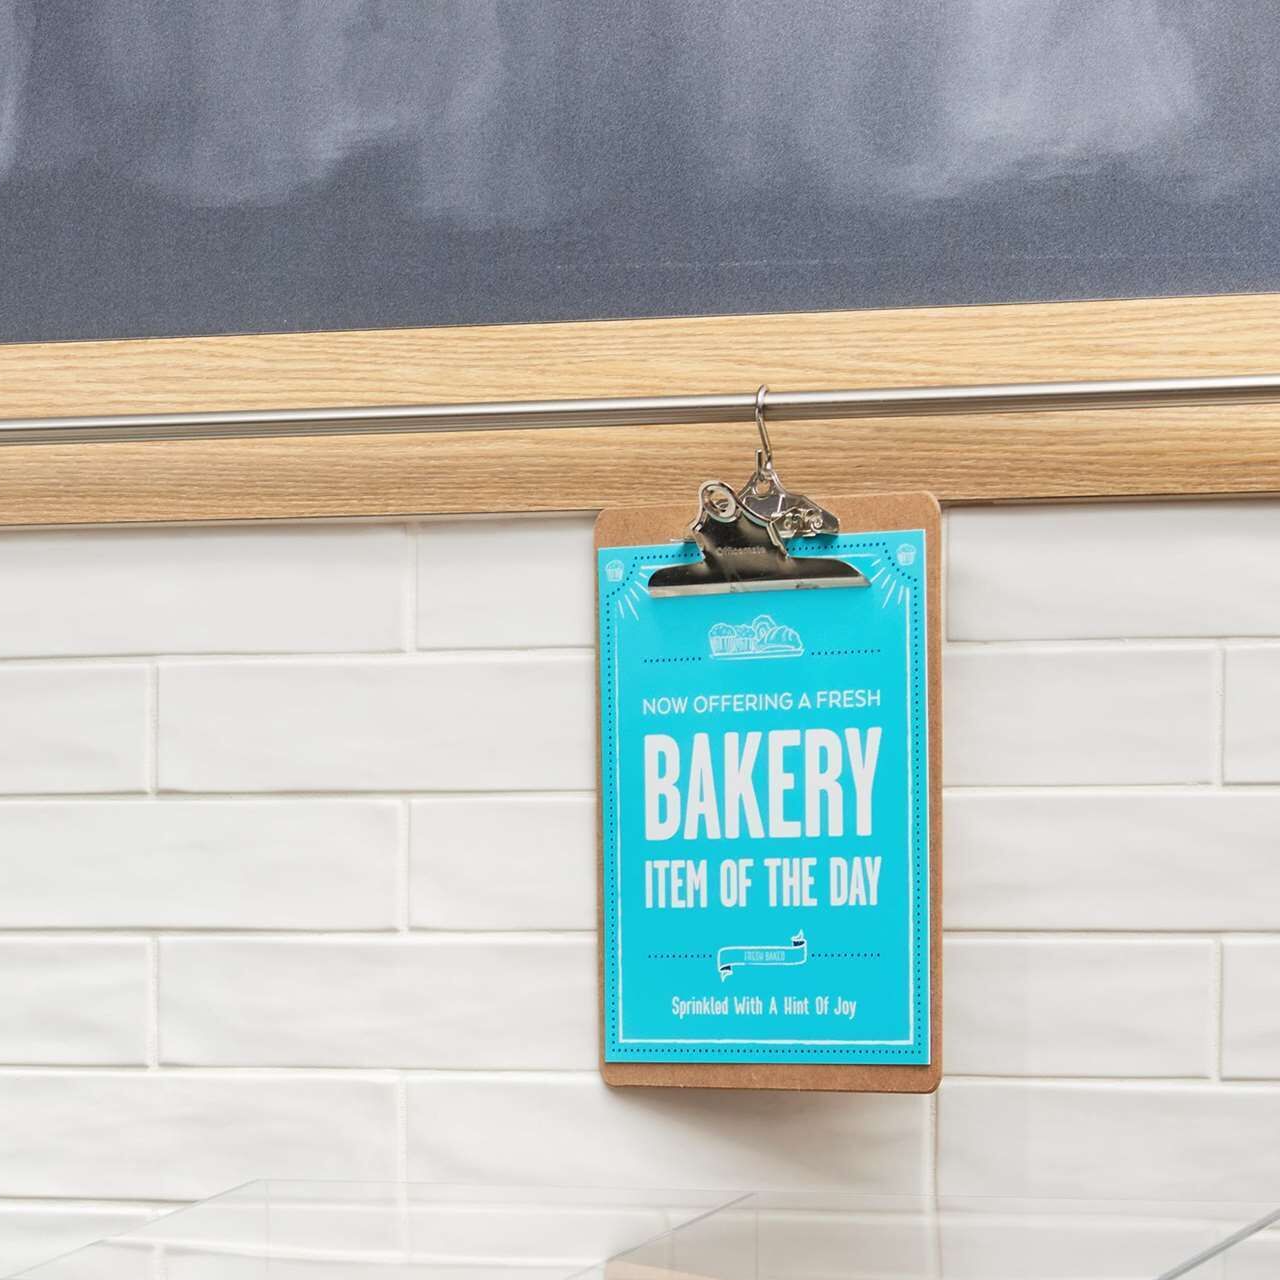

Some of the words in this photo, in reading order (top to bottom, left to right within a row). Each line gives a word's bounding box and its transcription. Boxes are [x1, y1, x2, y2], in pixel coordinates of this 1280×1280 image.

[642, 697, 688, 715] NOW
[693, 693, 793, 713] OFFERING
[798, 694, 812, 709] A
[816, 689, 881, 708] FRESH
[643, 726, 883, 841] BAKERY
[645, 858, 708, 909] ITEM
[720, 858, 754, 908] OF
[764, 857, 818, 907] THE
[829, 855, 883, 906] DAY
[671, 996, 728, 1020] Sprinkled
[734, 996, 763, 1015] With
[768, 996, 778, 1016] A
[783, 996, 809, 1015] Hint
[815, 996, 829, 1015] Of
[834, 996, 857, 1020] Joy
